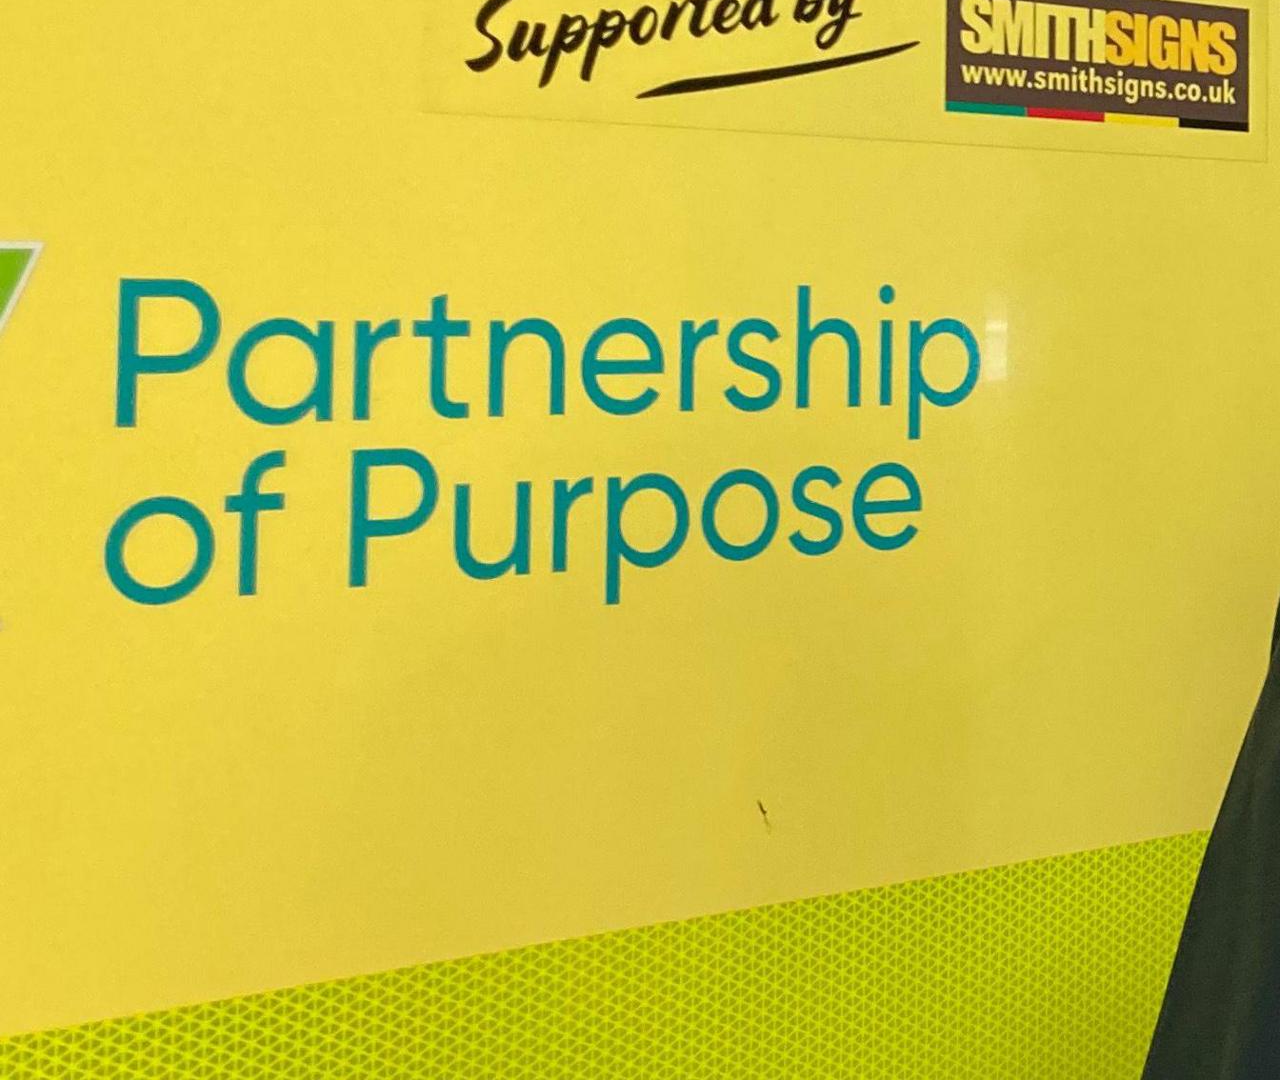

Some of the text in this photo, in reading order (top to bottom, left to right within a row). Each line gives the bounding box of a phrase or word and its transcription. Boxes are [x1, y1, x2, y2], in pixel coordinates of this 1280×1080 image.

[960, 64, 1237, 105] www.smithsigns.co.uk
[114, 277, 981, 440] Partnership
[103, 447, 924, 606] of Purpose
